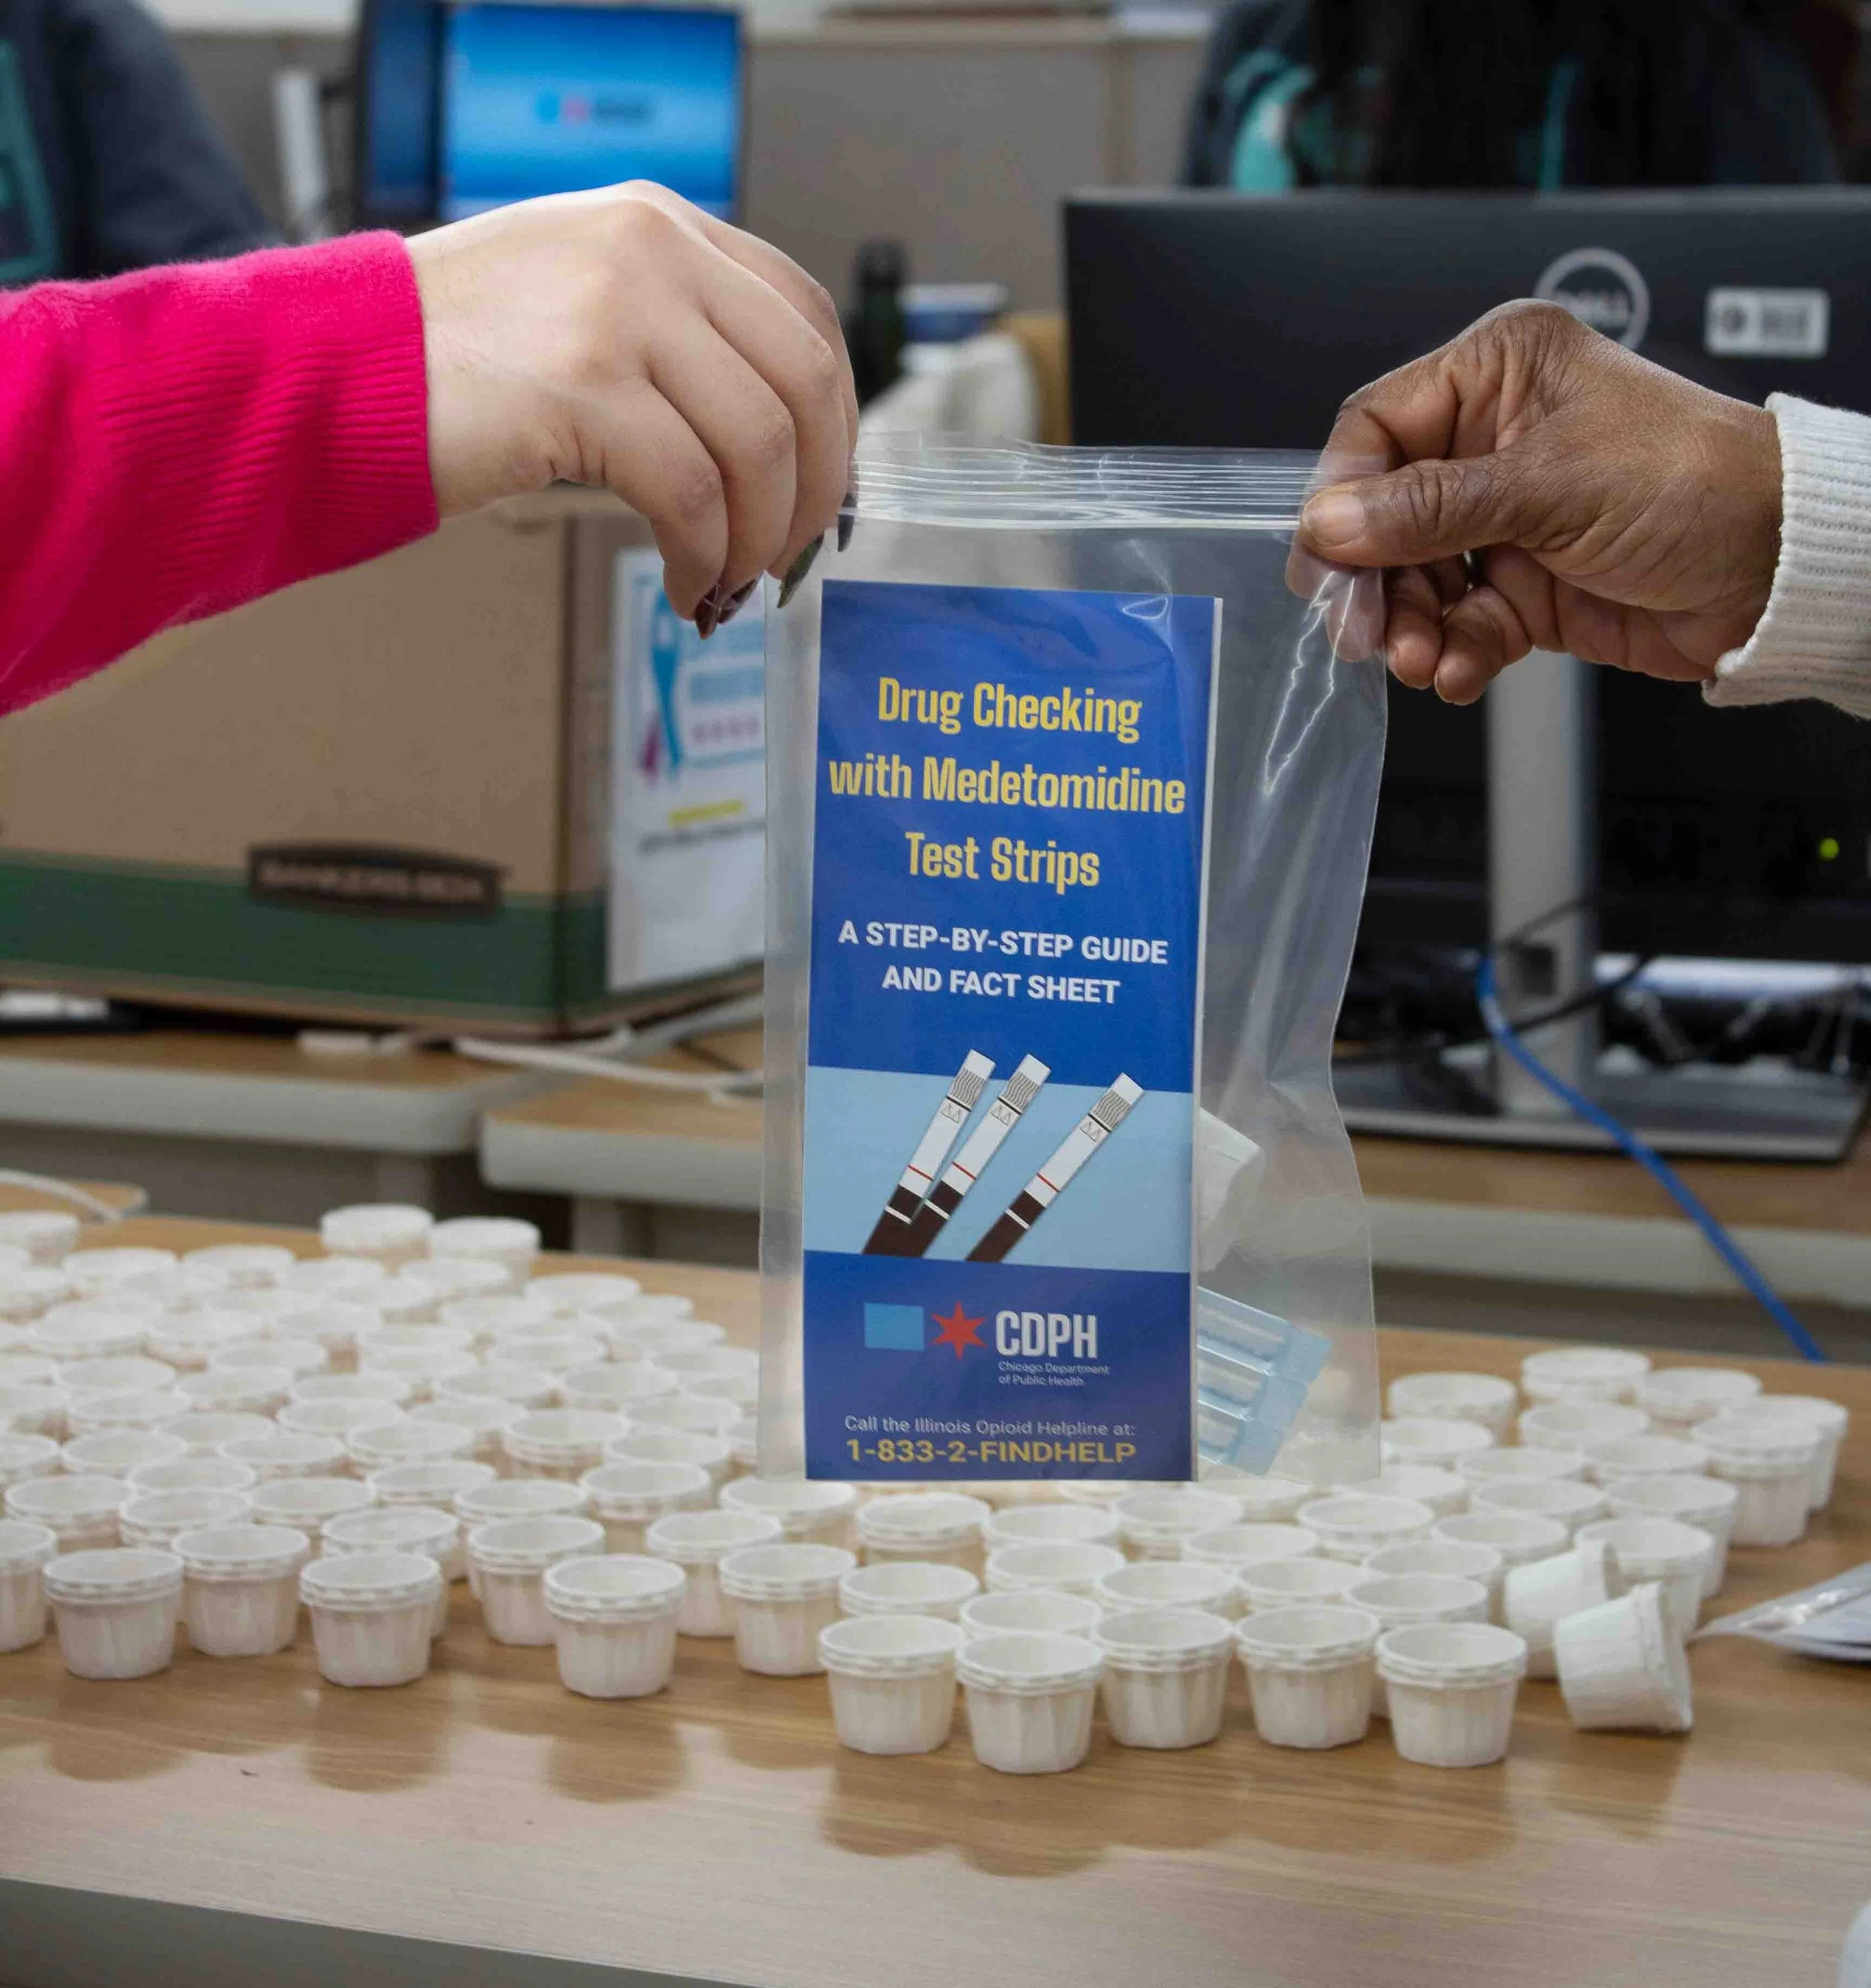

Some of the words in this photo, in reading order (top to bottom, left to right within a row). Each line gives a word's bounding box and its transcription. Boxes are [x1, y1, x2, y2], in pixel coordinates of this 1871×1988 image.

[879, 677, 963, 734] Drug
[974, 683, 1142, 743] Checking
[829, 753, 912, 799] with
[923, 757, 1185, 814] Medetomidine
[905, 832, 979, 879] Test
[991, 837, 1099, 894] Strips
[838, 920, 858, 944] A
[866, 922, 1073, 957] STEP-BY-STEP
[1081, 936, 1168, 964] GUIDE
[882, 966, 941, 991] AND
[950, 970, 1021, 997] FACT
[1028, 975, 1120, 1004] SHEET
[996, 1311, 1096, 1358] CDPH
[998, 1361, 1043, 1374] Chicago
[1045, 1362, 1110, 1376] Department
[998, 1374, 1011, 1385] of
[1013, 1375, 1047, 1385] Public
[1049, 1376, 1084, 1386] Health
[845, 1415, 877, 1431] Call
[882, 1417, 910, 1433] the
[915, 1418, 971, 1434] Illinois
[976, 1421, 1032, 1436] Opioid
[1037, 1421, 1108, 1439] Helpline
[1113, 1424, 1135, 1436] at:
[846, 1438, 1136, 1463] 1-833-2-FINDHELP
